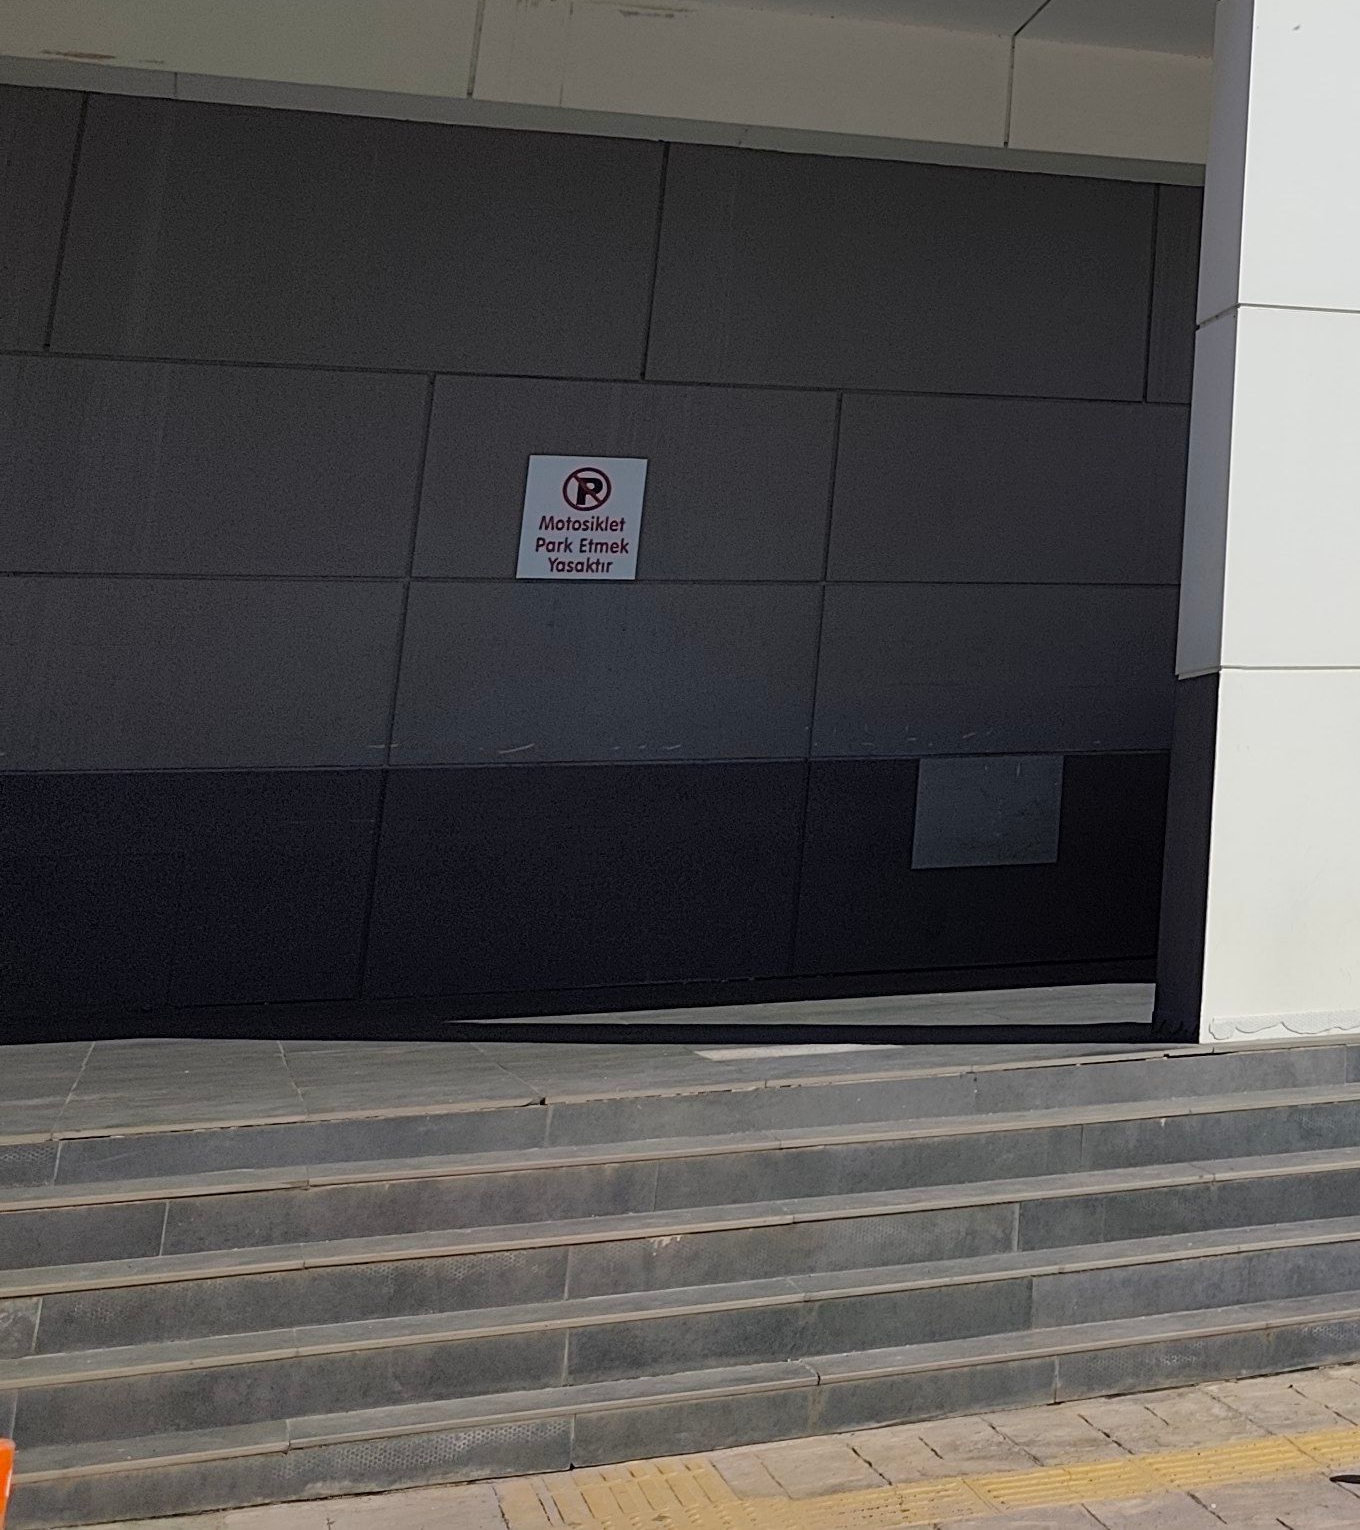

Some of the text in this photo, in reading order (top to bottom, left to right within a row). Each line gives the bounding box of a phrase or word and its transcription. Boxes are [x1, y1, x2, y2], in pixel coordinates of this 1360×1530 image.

[538, 515, 626, 532] Motosiklet
[535, 537, 629, 554] Park Etmek
[548, 557, 614, 573] Yasaktır
